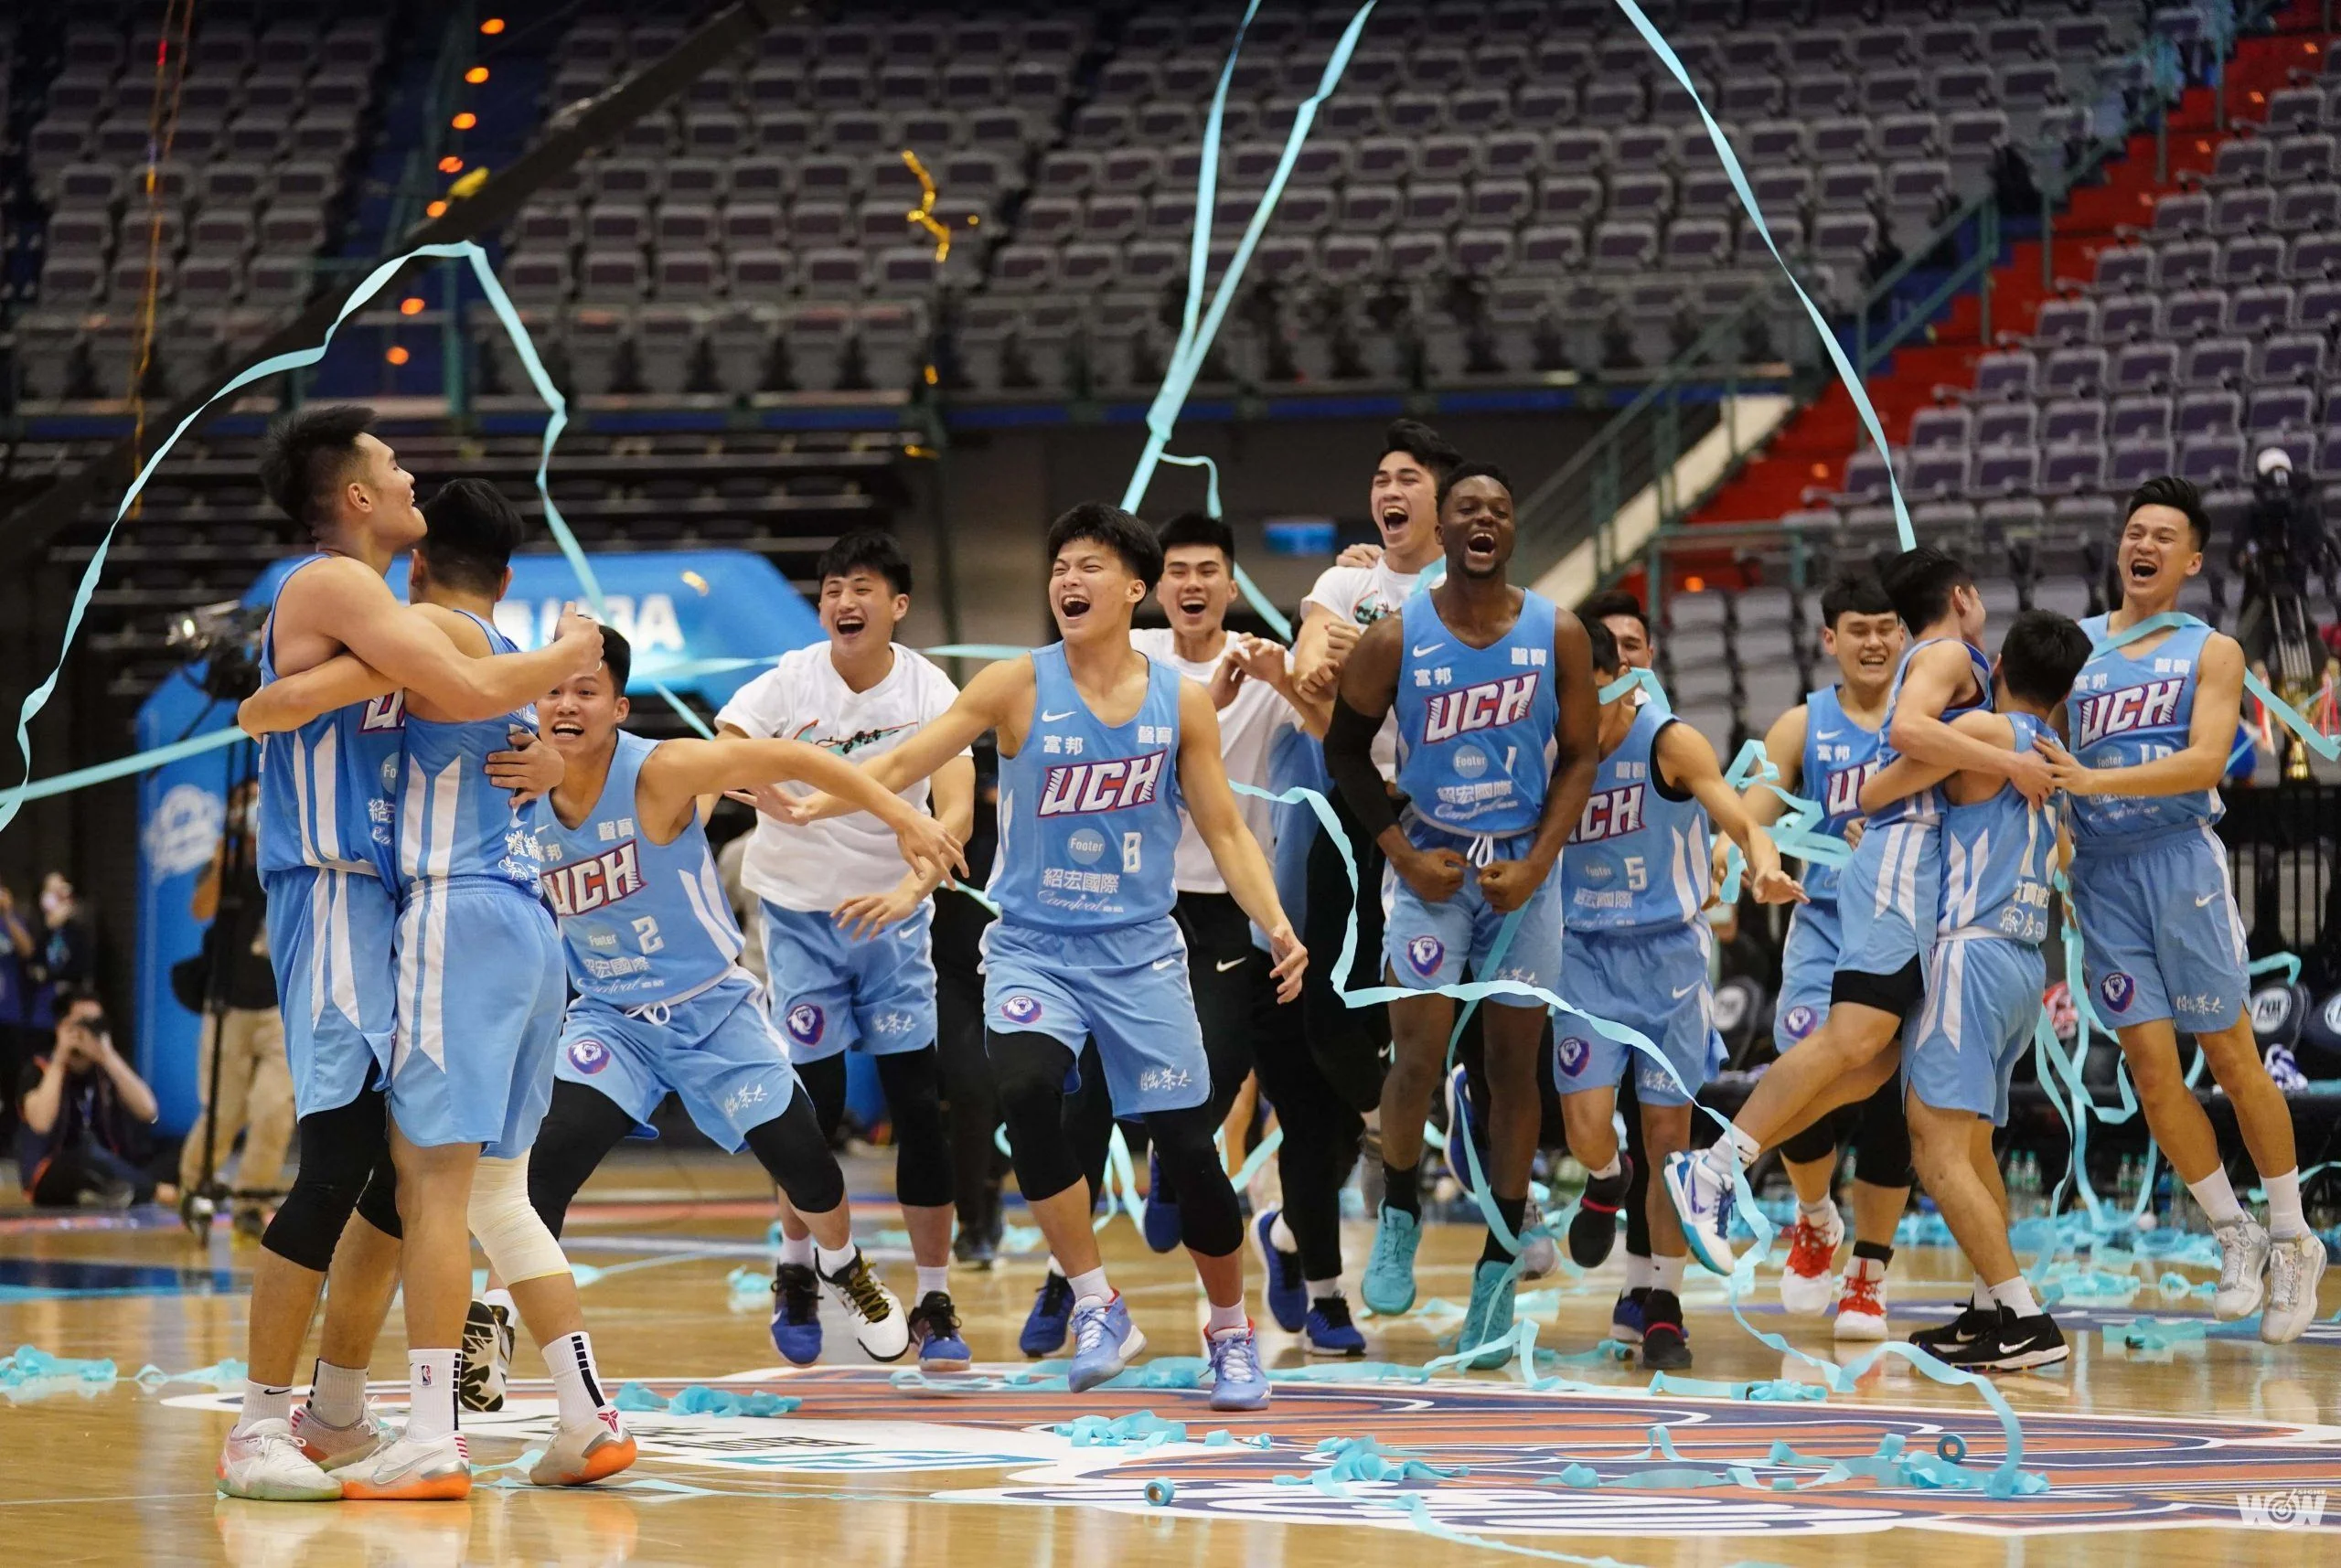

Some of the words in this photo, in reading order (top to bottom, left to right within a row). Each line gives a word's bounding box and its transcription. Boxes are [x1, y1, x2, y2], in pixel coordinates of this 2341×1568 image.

[1423, 672, 1539, 743] UCH
[2079, 677, 2186, 750] UCH
[1043, 735, 1083, 755] 富邦
[1456, 754, 1486, 767] Footer
[1505, 746, 1517, 773] 1
[1038, 748, 1167, 816] UCH
[1569, 784, 1644, 843] CH
[1070, 837, 1103, 852] Footer
[1123, 832, 1141, 873] 8
[540, 841, 644, 915] UCH
[1043, 868, 1120, 894] 紹宏國際
[1624, 857, 1647, 891] 5
[1038, 890, 1107, 912] Carnival
[631, 915, 664, 955] 2
